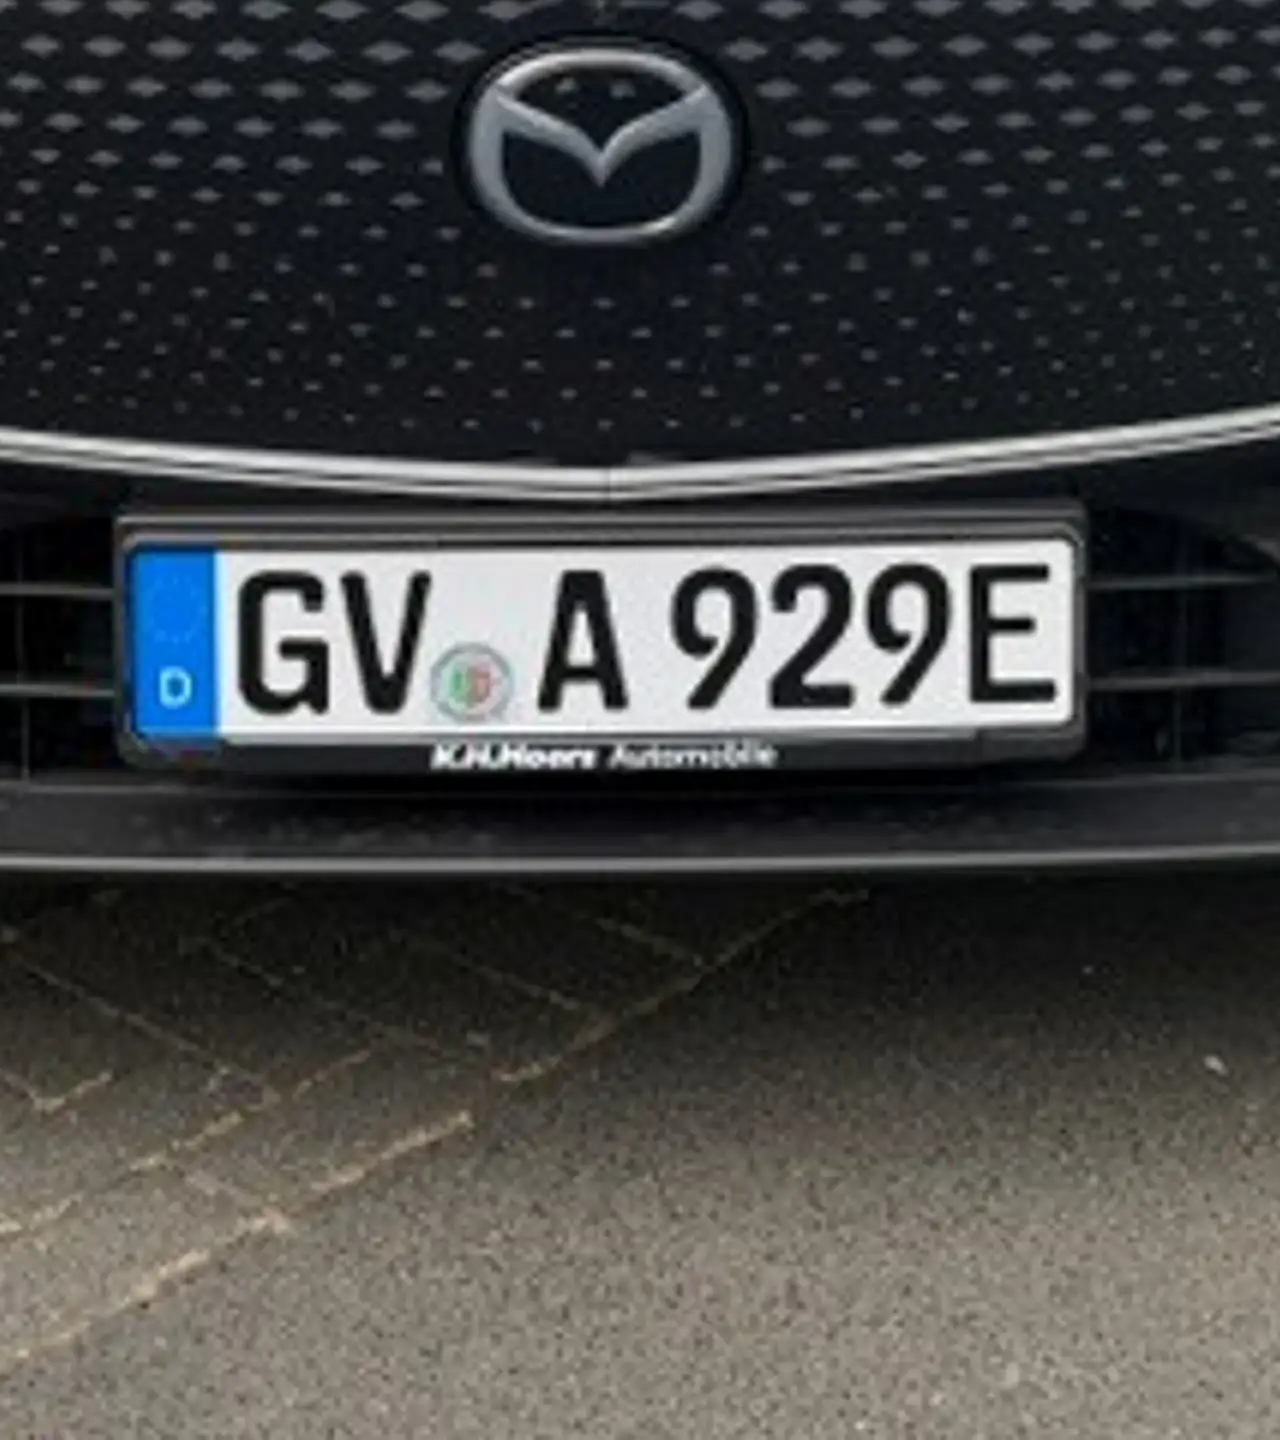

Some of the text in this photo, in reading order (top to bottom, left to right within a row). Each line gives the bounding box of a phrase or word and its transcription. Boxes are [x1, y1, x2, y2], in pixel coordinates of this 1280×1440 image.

[158, 666, 192, 709] D
[237, 570, 432, 715] GV
[537, 570, 629, 710] A
[670, 563, 1058, 709] 929E
